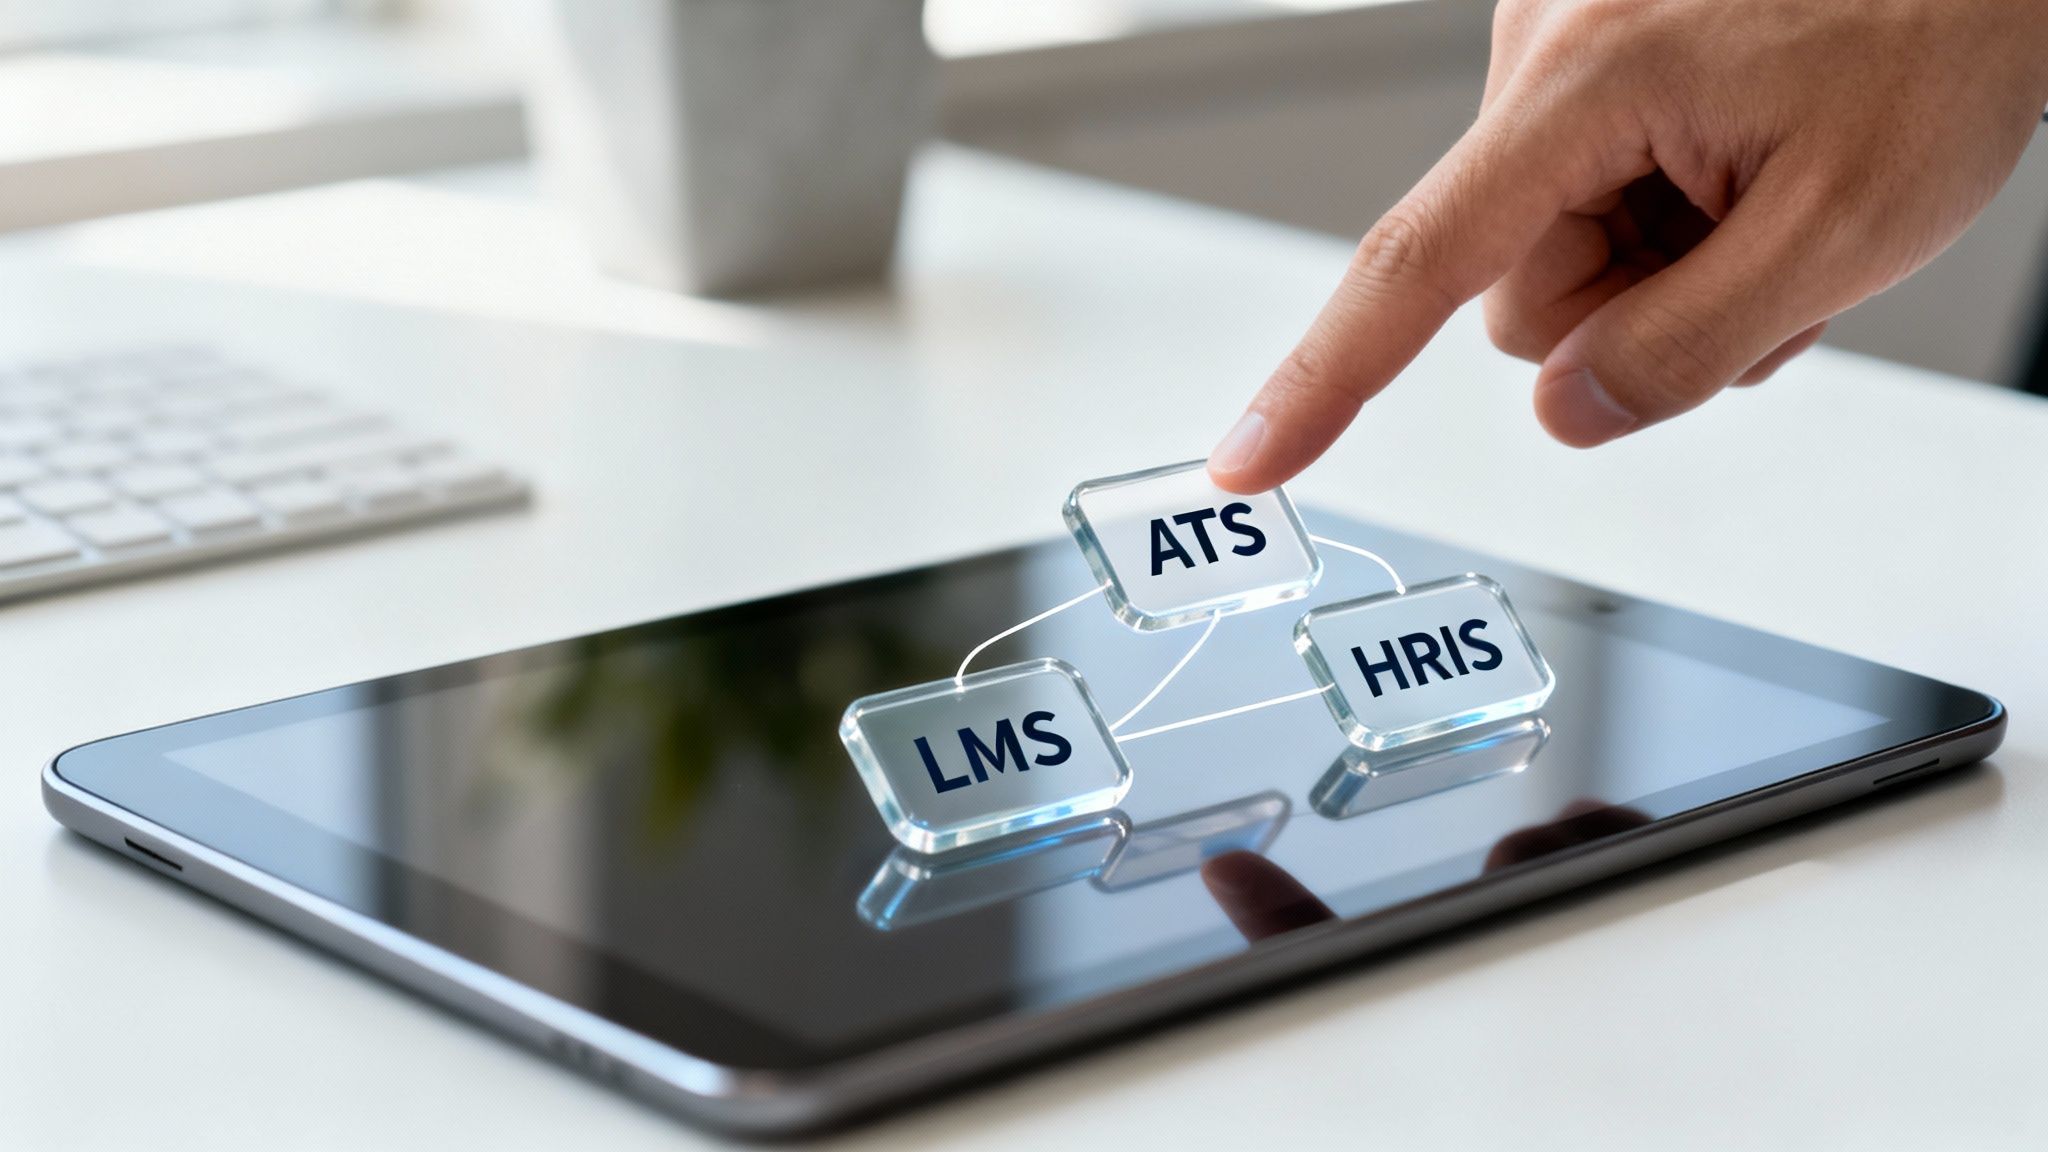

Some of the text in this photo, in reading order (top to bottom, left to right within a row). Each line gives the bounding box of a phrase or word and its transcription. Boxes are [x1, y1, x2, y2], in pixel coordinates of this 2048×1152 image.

[1150, 502, 1267, 576] ATS
[1351, 618, 1503, 697] HRIS
[913, 710, 1072, 794] LMS
